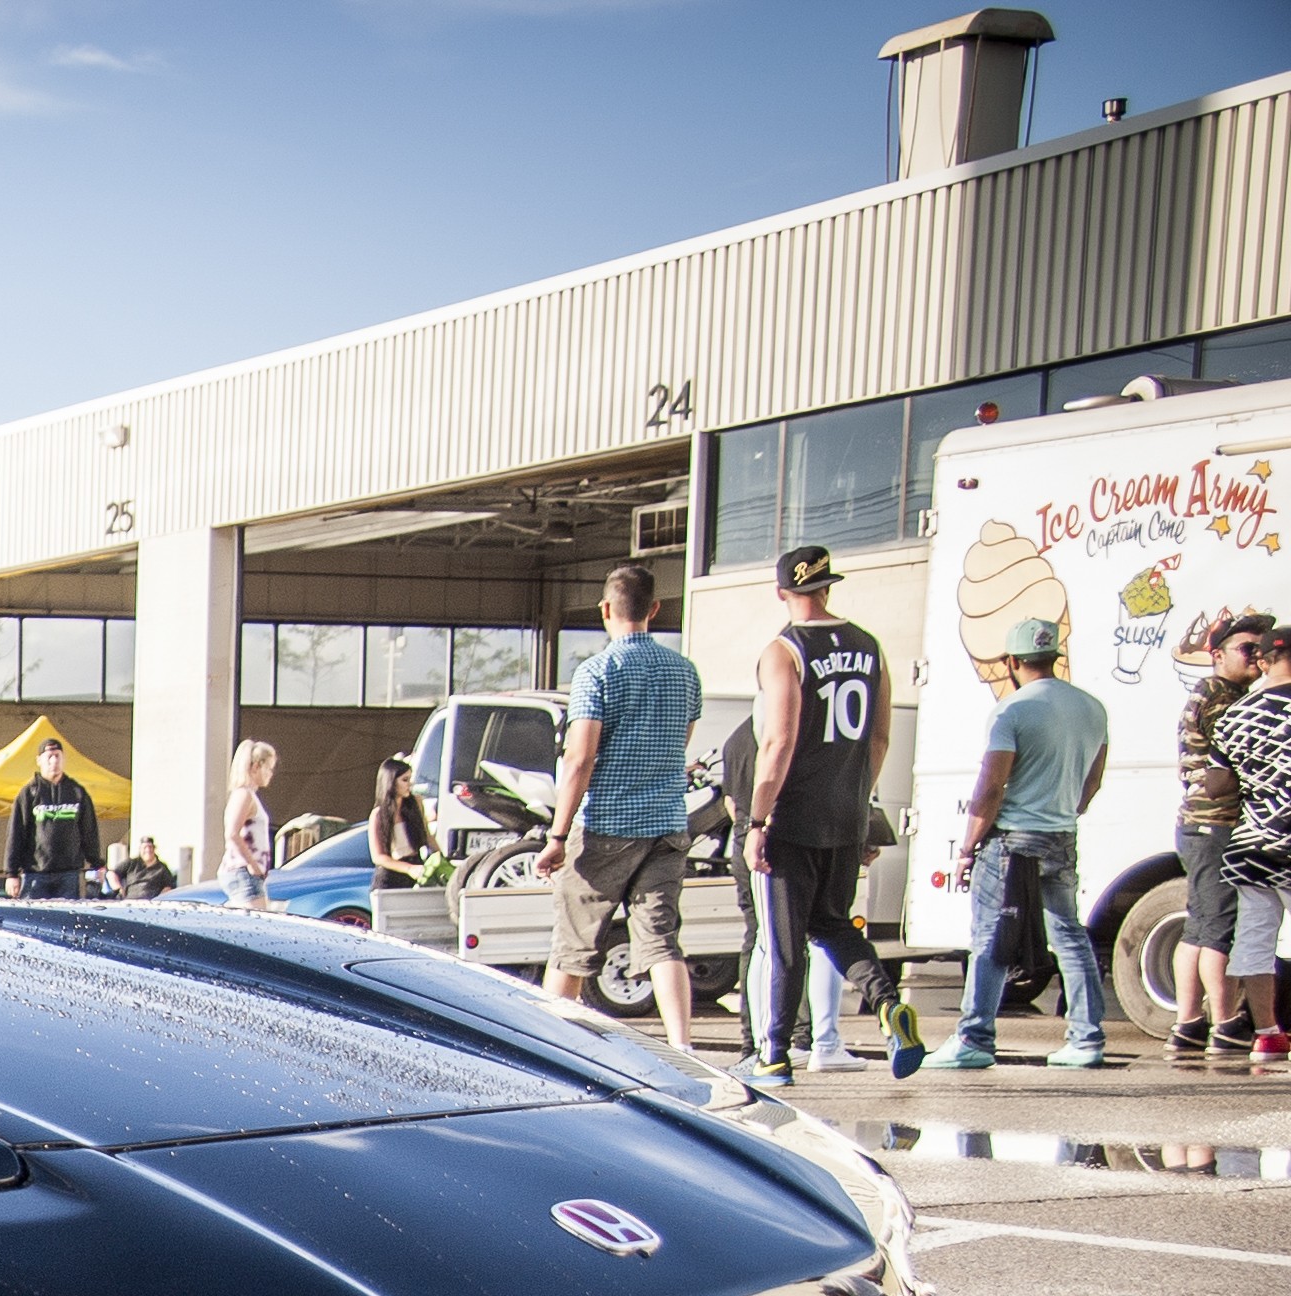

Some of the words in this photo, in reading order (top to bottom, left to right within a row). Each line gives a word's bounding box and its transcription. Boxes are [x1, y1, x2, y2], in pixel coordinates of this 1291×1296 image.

[646, 379, 693, 428] 24
[105, 500, 133, 535] 25
[1035, 502, 1084, 556] Ice
[1089, 473, 1179, 522] Cream
[1182, 459, 1278, 550] Army
[1086, 517, 1146, 559] Captain
[1148, 510, 1187, 545] Cone
[1113, 626, 1167, 649] SLUSH
[816, 678, 868, 744] 10
